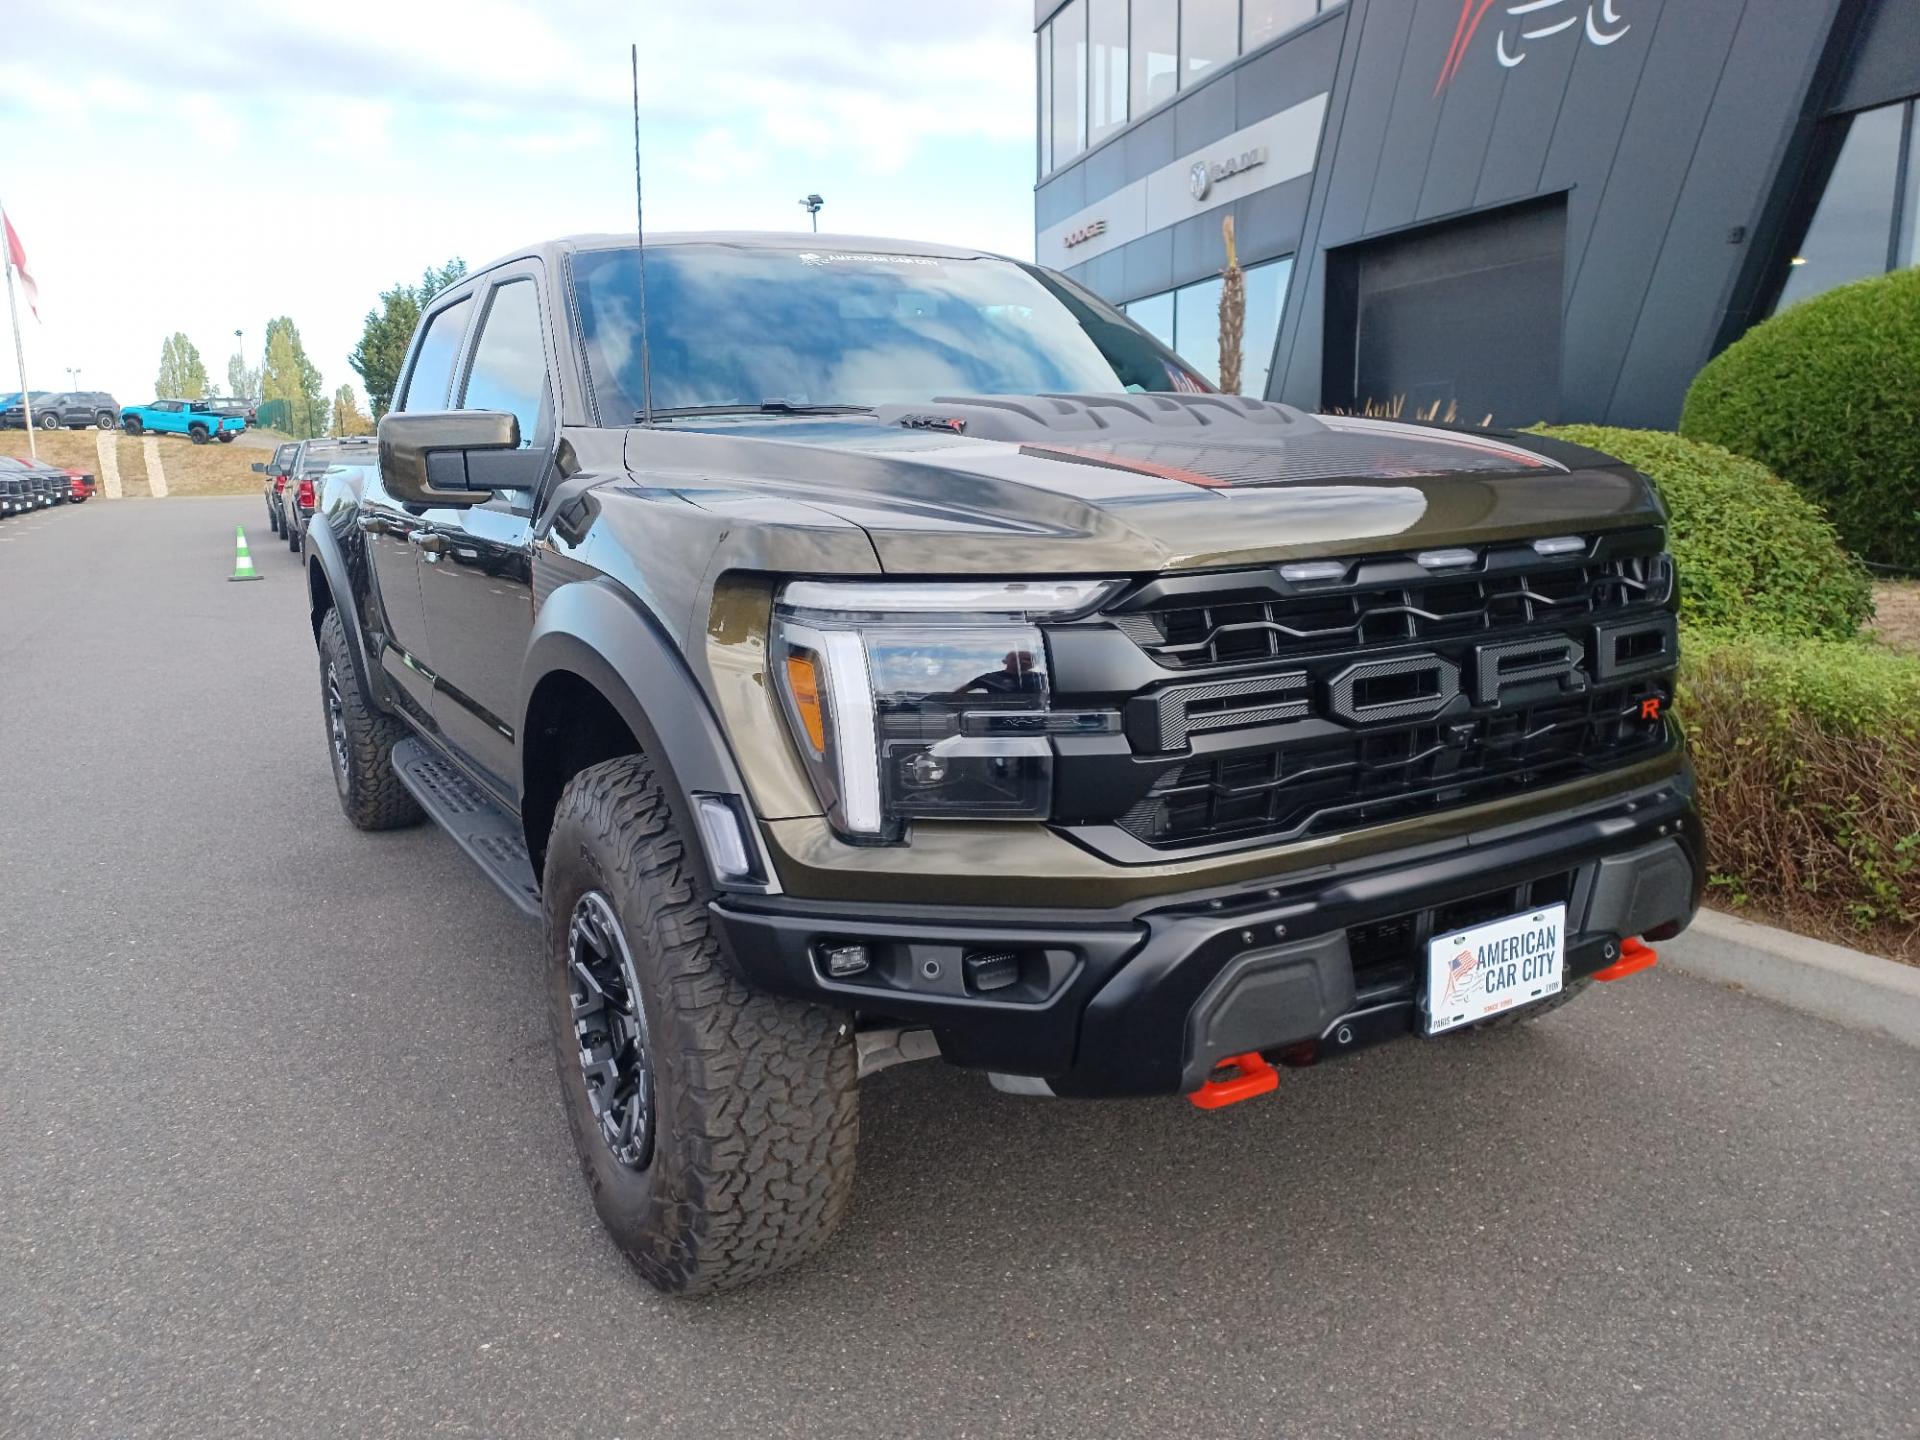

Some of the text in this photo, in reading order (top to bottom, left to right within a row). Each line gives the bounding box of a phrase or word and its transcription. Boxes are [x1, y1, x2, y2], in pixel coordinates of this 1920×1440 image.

[1211, 147, 1268, 183] RAM
[1063, 220, 1106, 248] DODGE
[1155, 617, 1677, 752] FORD
[1477, 925, 1556, 993] AMERICAN CAR CITY
[1433, 1016, 1451, 1030] PARIS
